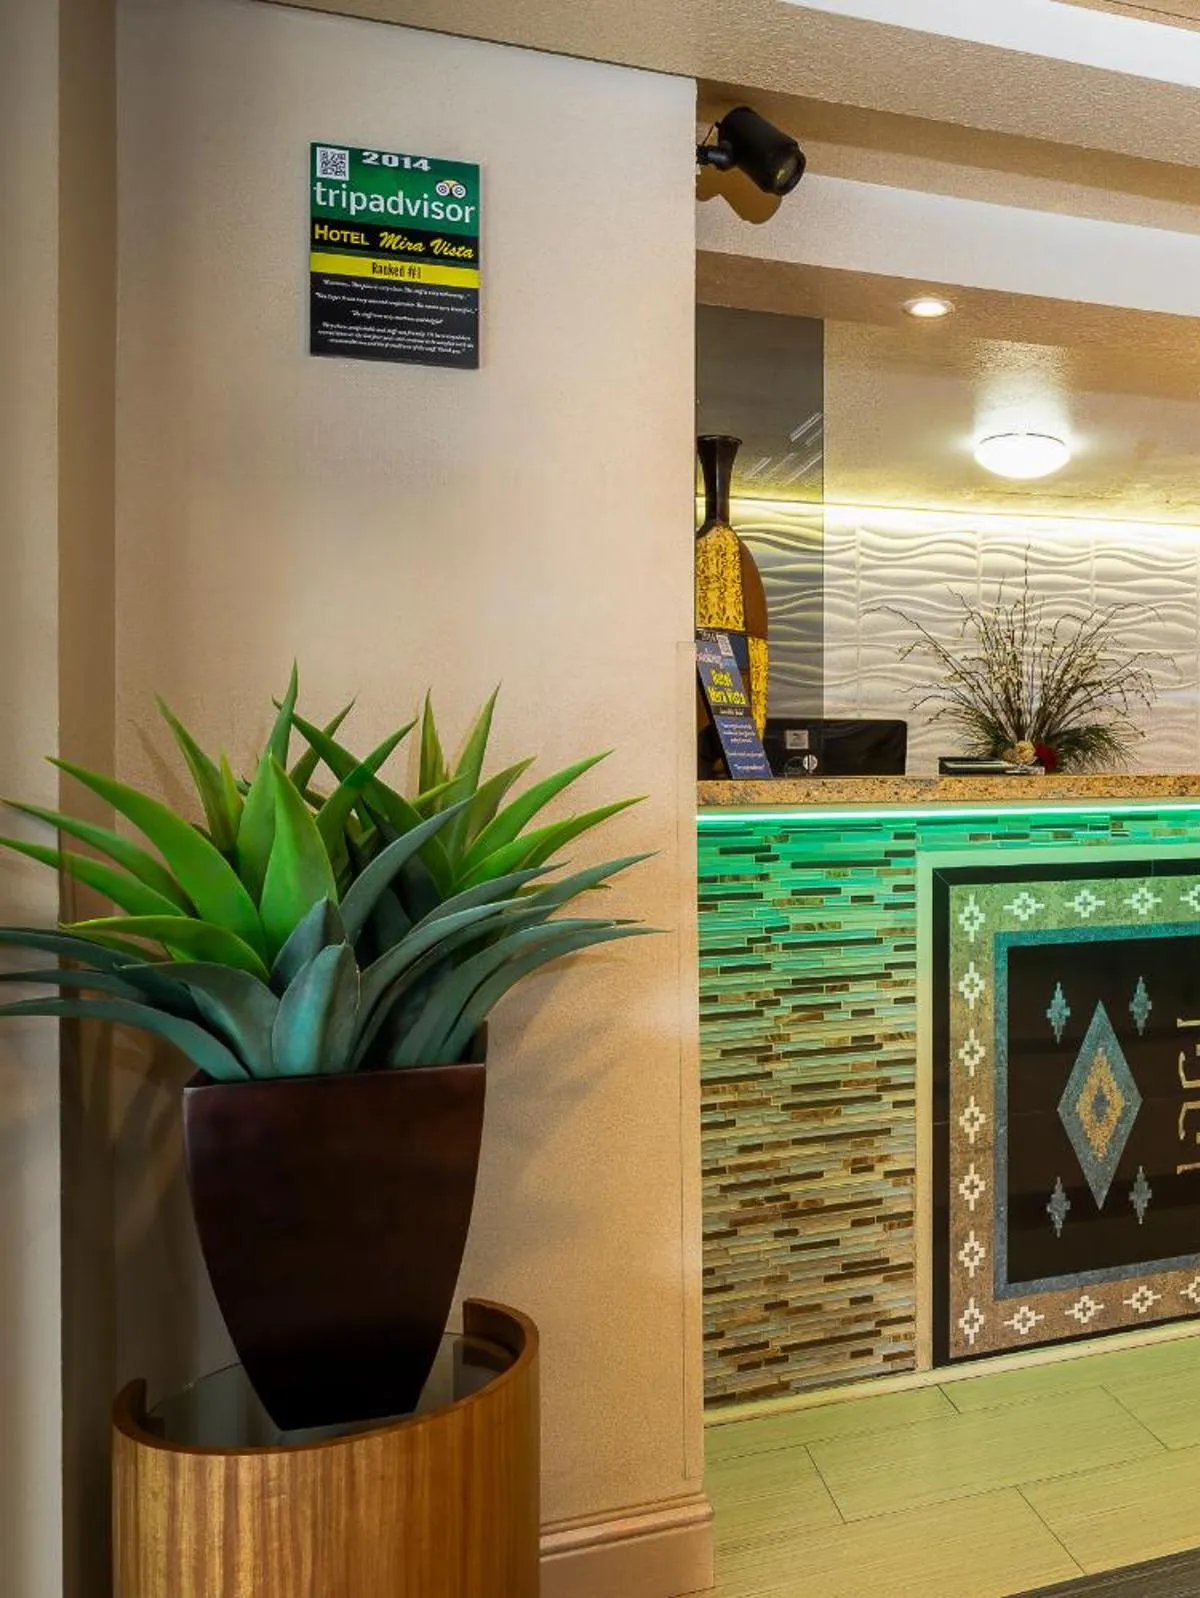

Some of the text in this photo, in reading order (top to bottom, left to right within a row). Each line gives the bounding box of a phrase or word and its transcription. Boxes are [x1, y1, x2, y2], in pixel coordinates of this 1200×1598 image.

[362, 151, 431, 172] 2014
[313, 181, 476, 224] tripadvisor
[379, 231, 425, 252] Mira
[430, 238, 474, 259] Vista
[371, 261, 406, 278] Ranked
